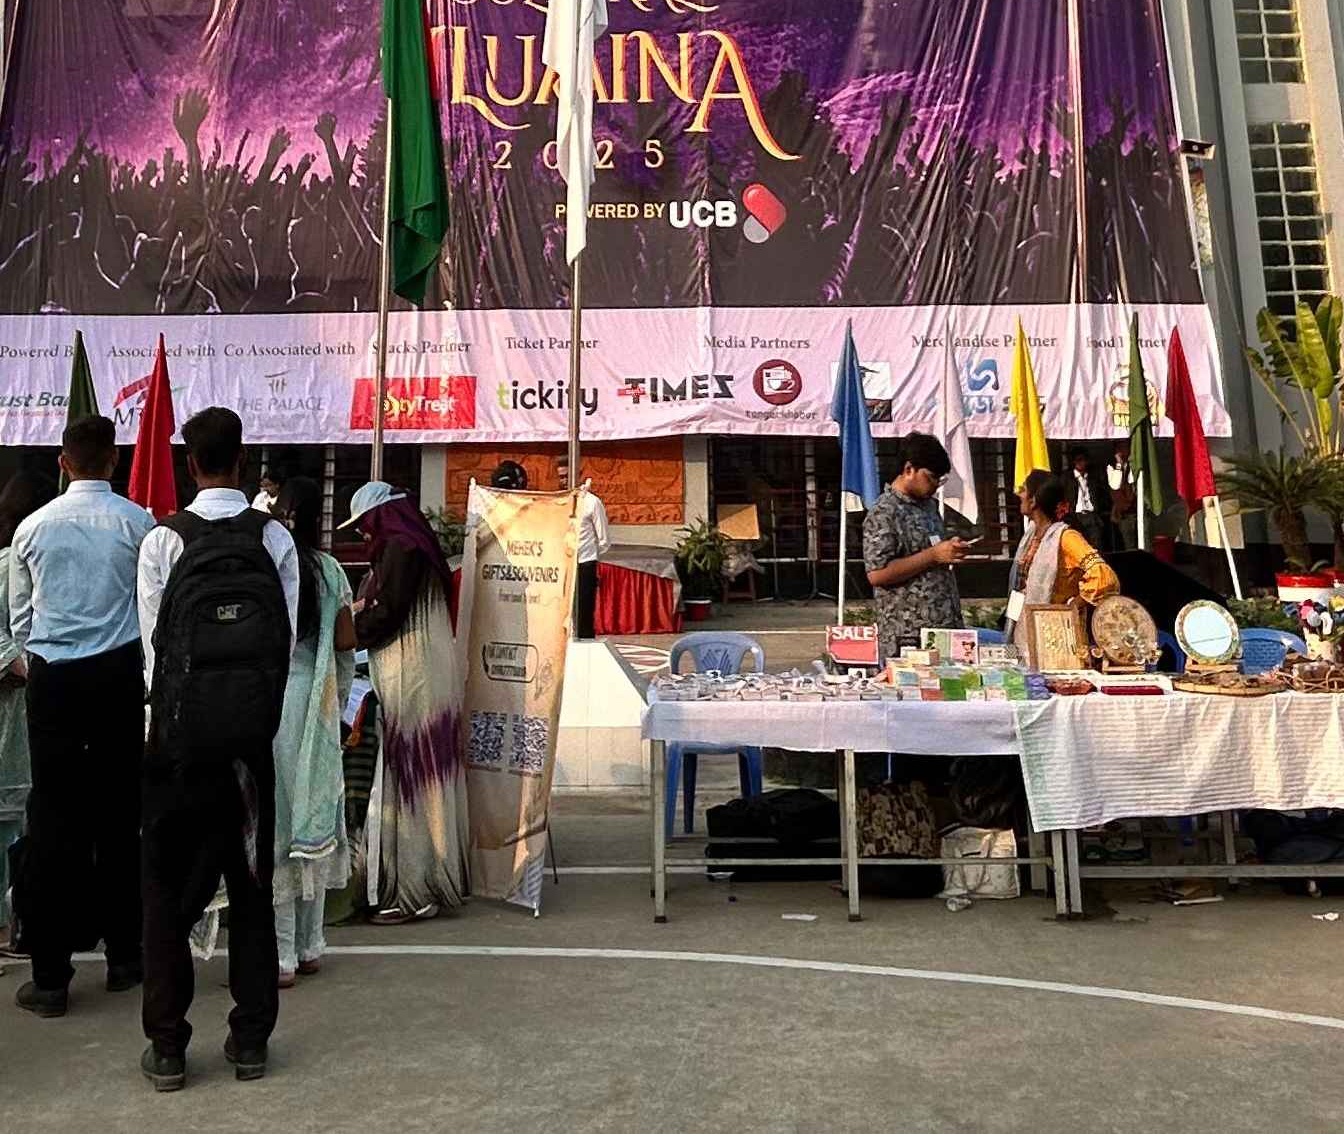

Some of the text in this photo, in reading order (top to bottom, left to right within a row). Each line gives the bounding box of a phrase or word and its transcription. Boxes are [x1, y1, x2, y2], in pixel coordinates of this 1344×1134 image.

[555, 200, 738, 228] PWERED BY UCB
[372, 341, 418, 355] Sacks
[505, 336, 599, 350] Ticket Parner
[703, 335, 810, 349] Media Partners
[912, 334, 1057, 348] Mercandise Patner
[0, 345, 58, 358] Powered
[107, 343, 216, 358] Associed with
[224, 341, 356, 357] Co Associated with
[268, 396, 325, 411] PALACE
[496, 379, 599, 416] tickiy
[831, 626, 874, 641] SALE
